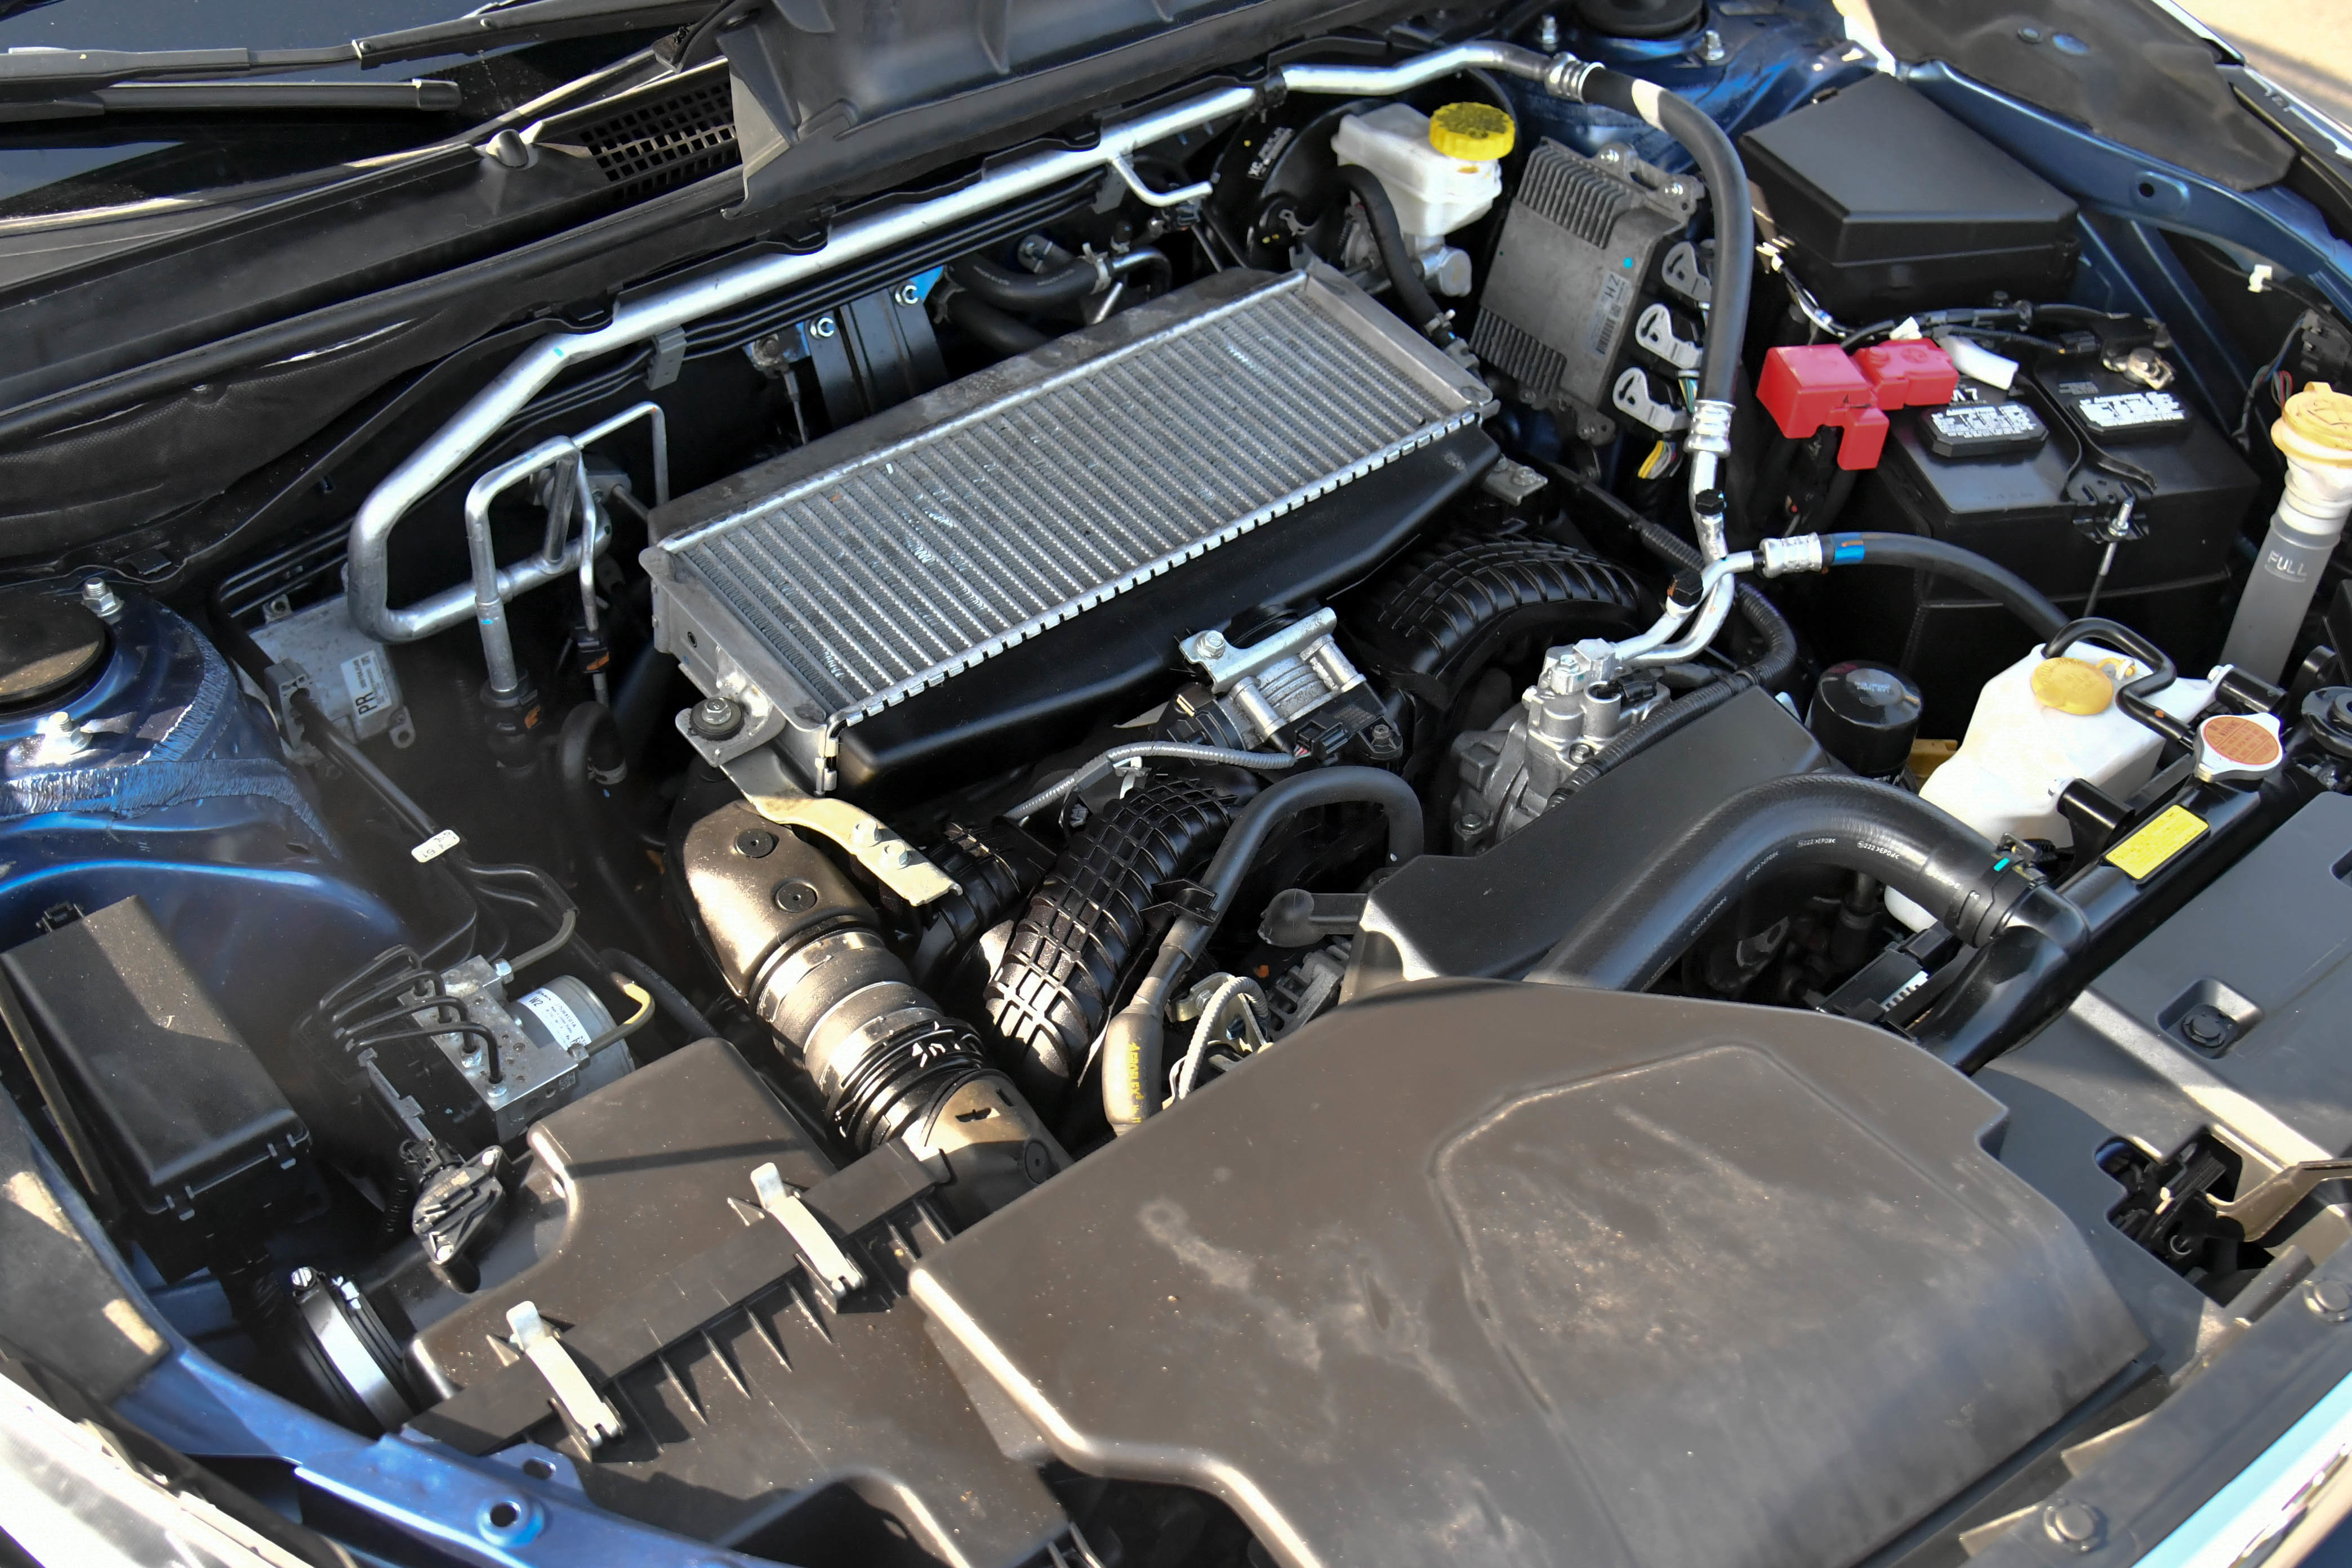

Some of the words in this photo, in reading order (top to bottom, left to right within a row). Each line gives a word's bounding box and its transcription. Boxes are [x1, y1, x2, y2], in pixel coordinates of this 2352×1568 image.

[2267, 550, 2307, 576] FULL
[355, 692, 378, 715] PR
[528, 996, 543, 1007] W2
